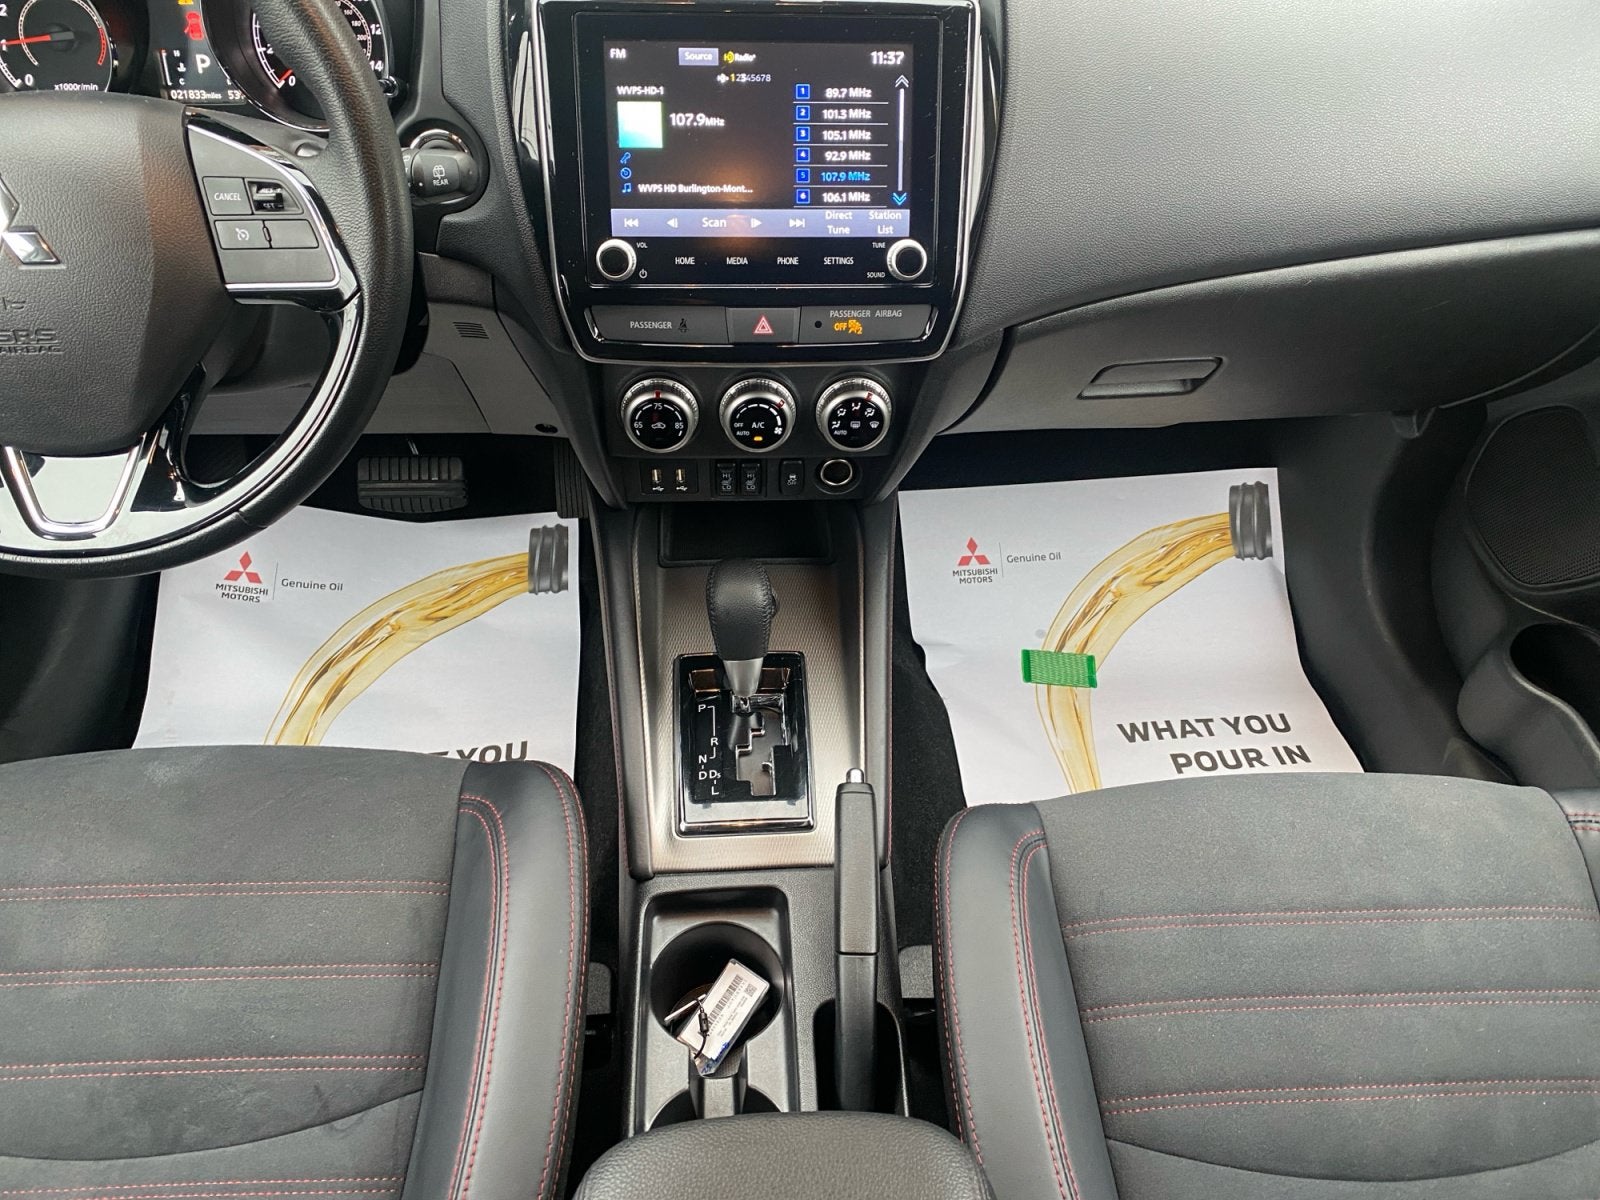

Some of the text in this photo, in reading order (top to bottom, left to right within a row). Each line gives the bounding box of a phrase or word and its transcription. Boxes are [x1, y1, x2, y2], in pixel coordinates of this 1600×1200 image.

[610, 48, 627, 59] FM
[684, 52, 713, 61] Source
[871, 51, 905, 65] 11:37
[195, 54, 211, 74] P
[24, 74, 34, 86] 0
[288, 76, 296, 87] 0
[54, 82, 98, 91] x1000r/min
[616, 86, 665, 95] WVPS-HD-1
[825, 88, 847, 98] 89.7
[848, 87, 872, 97] MHz
[822, 109, 847, 119] 101.3
[848, 108, 872, 119] MHz
[822, 130, 847, 140] 105.1
[848, 129, 872, 140] MHz
[824, 151, 847, 161] 92.9
[848, 150, 872, 160] MHz
[821, 172, 847, 182] 107.9
[848, 171, 871, 181] MHz
[638, 183, 662, 193] WVPS
[664, 183, 677, 193] HD
[213, 192, 242, 201] CANCEL
[822, 192, 847, 202] 106.1
[848, 191, 871, 202] MHz
[825, 211, 853, 220] Direct
[869, 211, 902, 220] Station
[702, 217, 727, 228] Scan
[827, 225, 850, 234] Tune
[877, 225, 893, 234] List
[674, 256, 695, 265] HOME
[726, 256, 748, 265] MEDIA
[776, 256, 799, 265] PHONE
[823, 256, 854, 265] SETTINGS
[829, 309, 903, 318] PASSENGER AIRBAG
[629, 320, 673, 329] PASSENGER
[833, 322, 847, 332] OFF
[653, 402, 663, 410] 75
[633, 421, 643, 429] 65
[674, 422, 684, 430] 85
[1006, 551, 1061, 564] Genuine Oil
[952, 567, 998, 577] MITSUBISHI
[959, 575, 993, 584] MOTORS
[281, 578, 344, 592] Genuine Oil
[215, 583, 269, 597] MITSUBISHI
[221, 592, 261, 603] MOTORS
[698, 704, 706, 712] P
[1116, 713, 1292, 743] WHAT YOU
[711, 737, 719, 746] R
[698, 754, 707, 764] N
[1169, 745, 1312, 774] POUR IN
[698, 771, 707, 780] D
[711, 786, 719, 795] L
